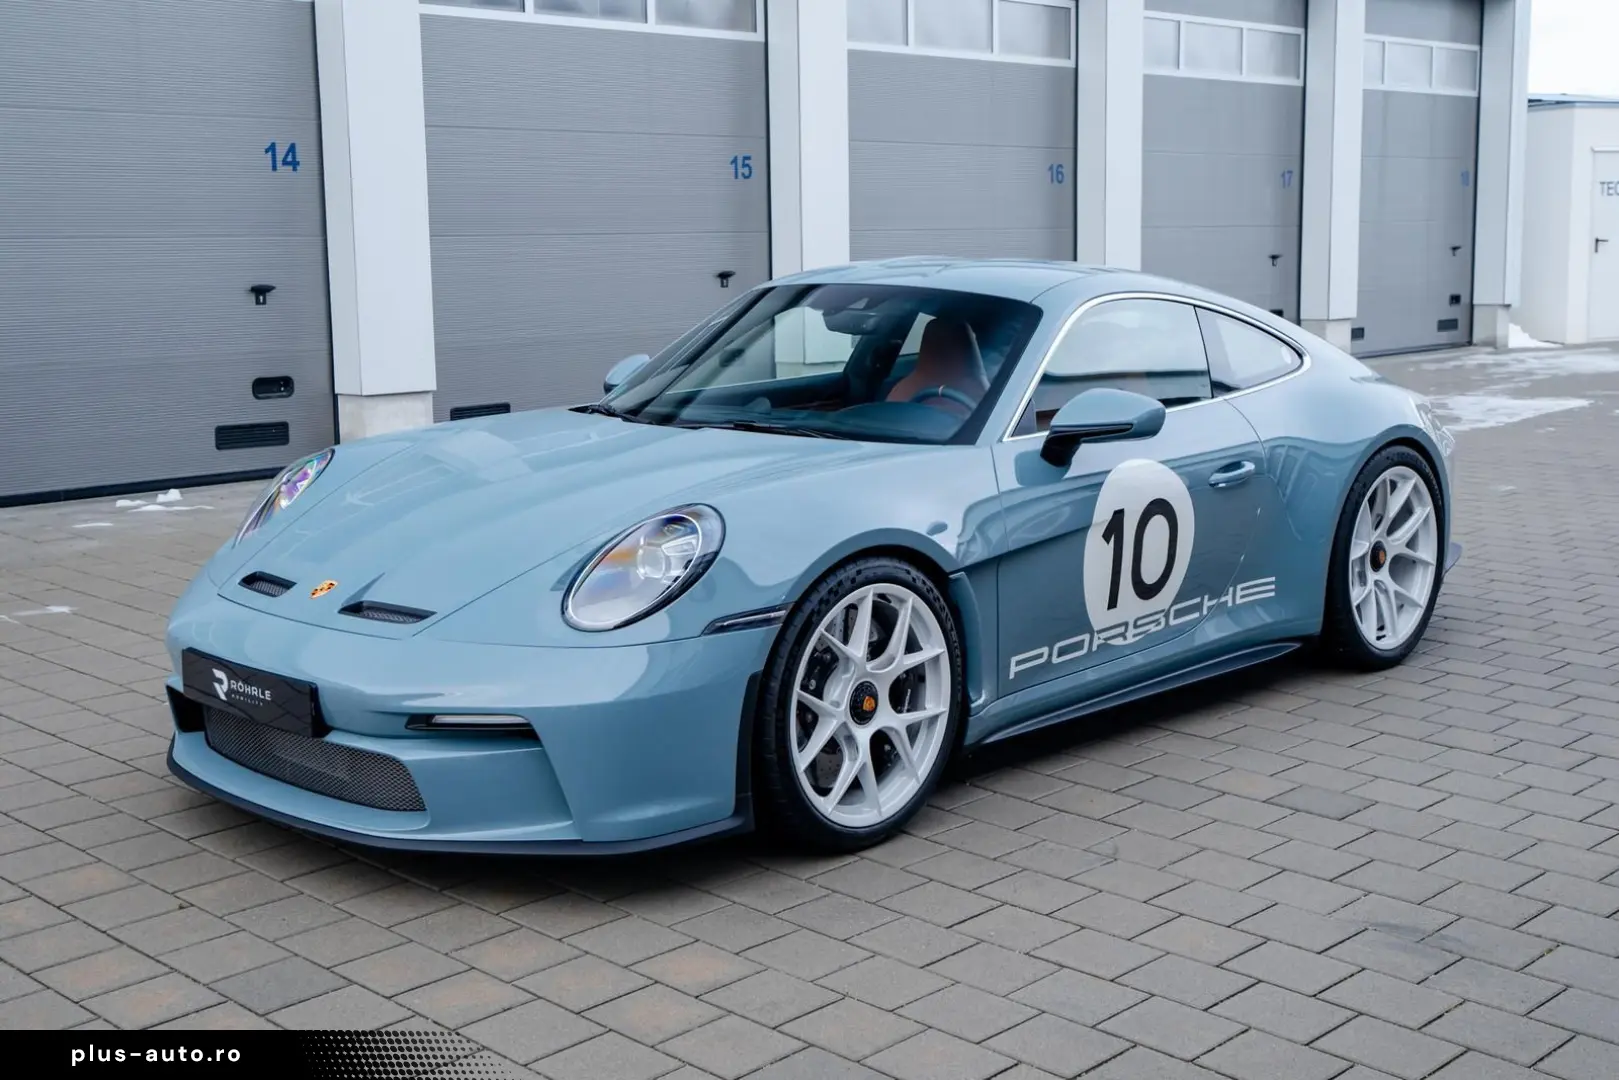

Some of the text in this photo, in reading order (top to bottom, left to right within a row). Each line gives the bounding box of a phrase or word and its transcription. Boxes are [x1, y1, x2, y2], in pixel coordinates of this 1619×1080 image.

[264, 141, 300, 172] 14
[730, 155, 753, 180] 15
[1047, 163, 1065, 185] 16
[1281, 170, 1294, 189] 17
[1101, 497, 1179, 611] 10
[1008, 576, 1276, 680] PORSCHE
